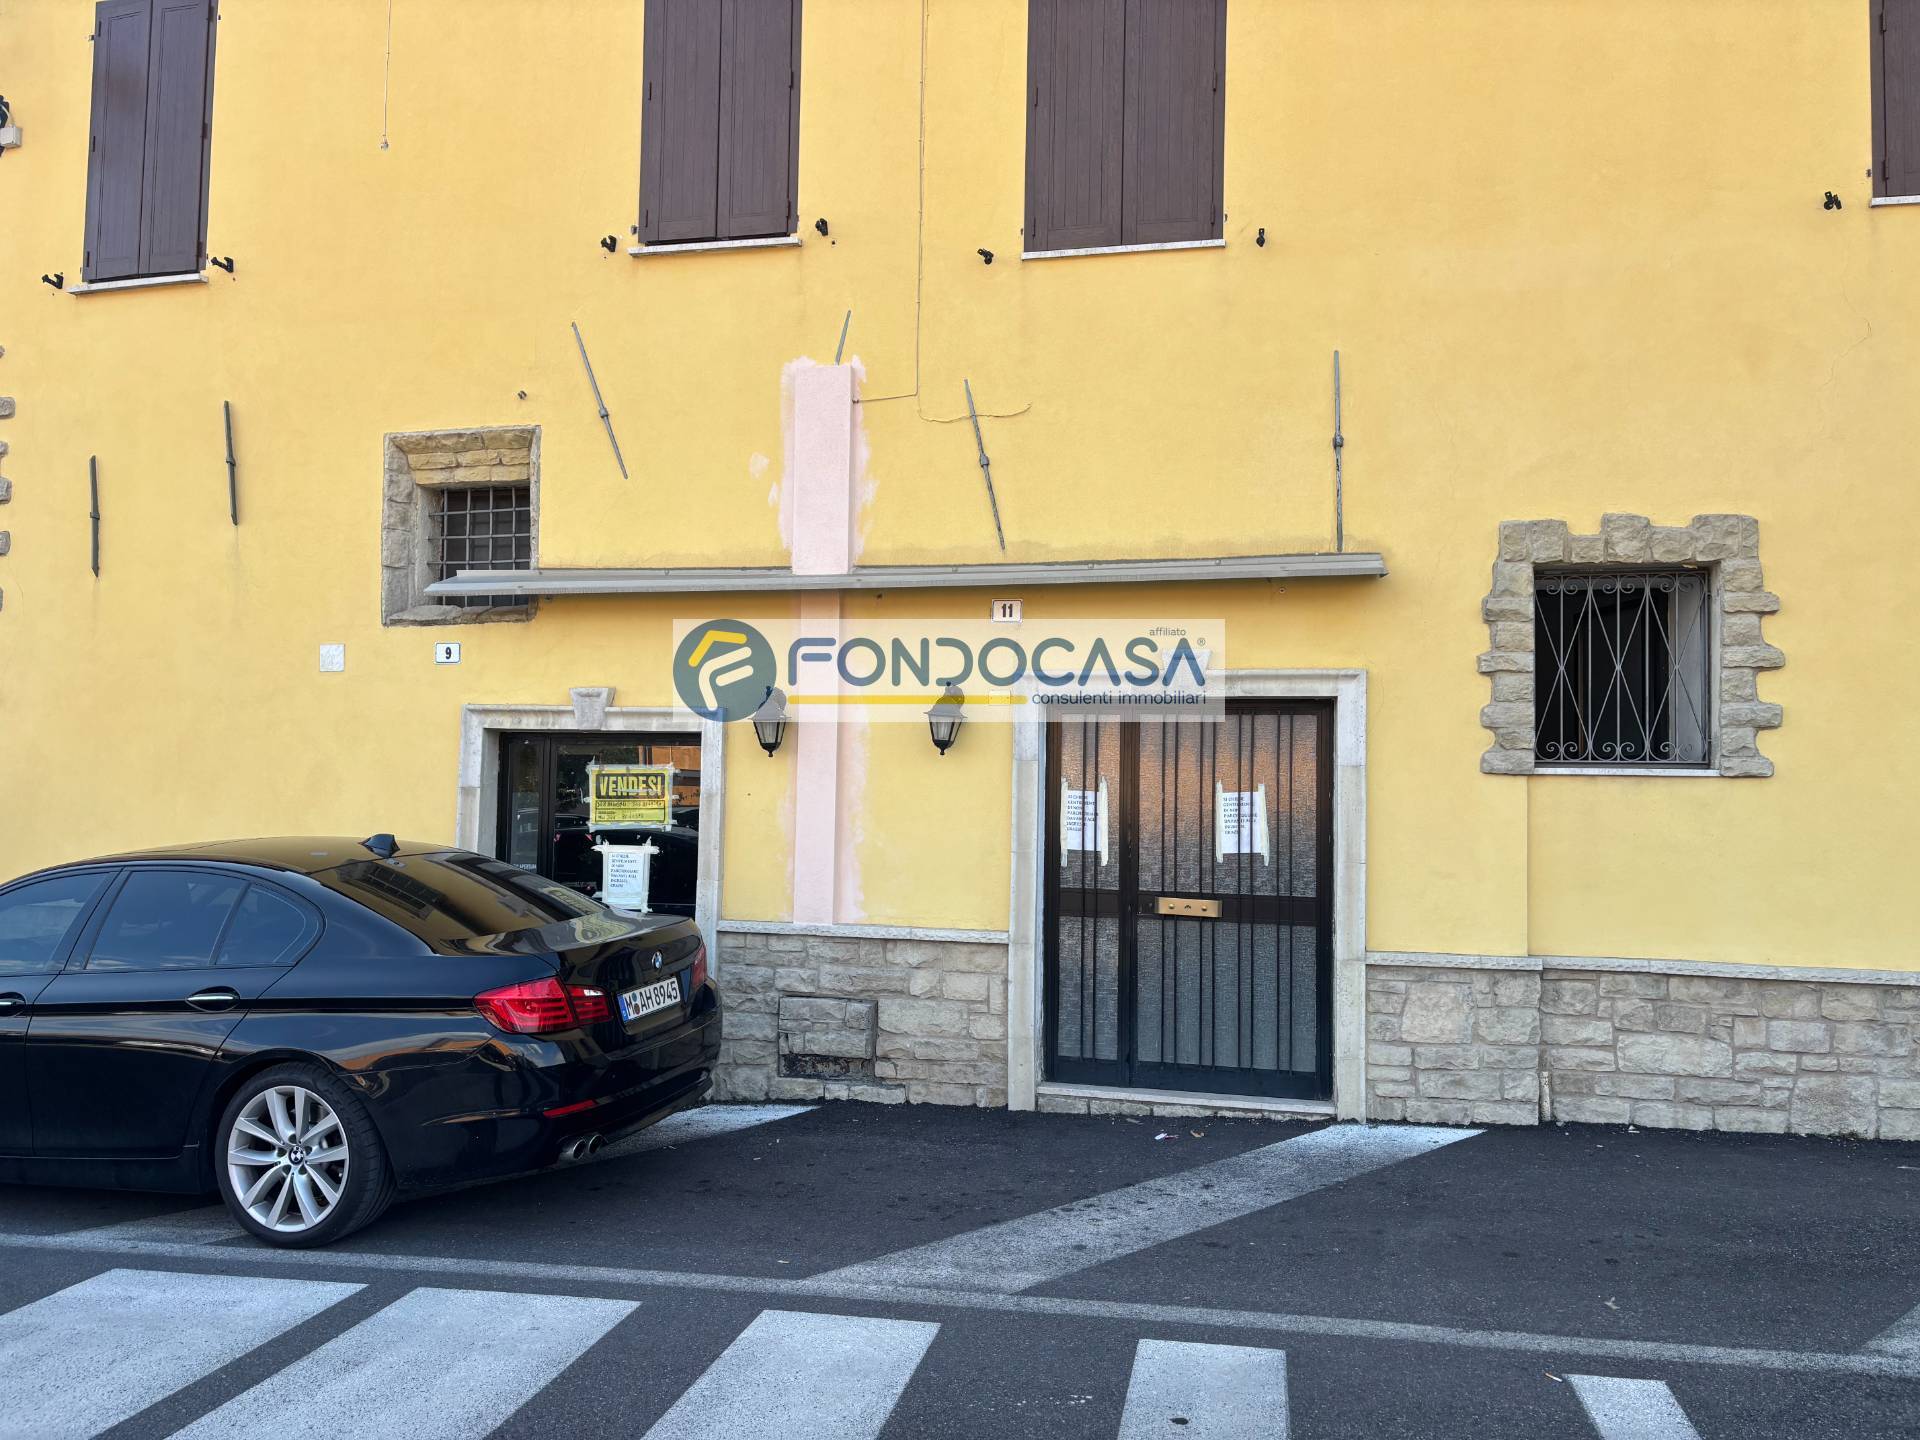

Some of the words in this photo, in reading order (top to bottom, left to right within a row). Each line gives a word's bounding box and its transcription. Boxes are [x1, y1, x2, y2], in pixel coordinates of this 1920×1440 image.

[1001, 603, 1013, 618] 11
[445, 646, 452, 660] 9
[599, 775, 662, 796] VENDESI
